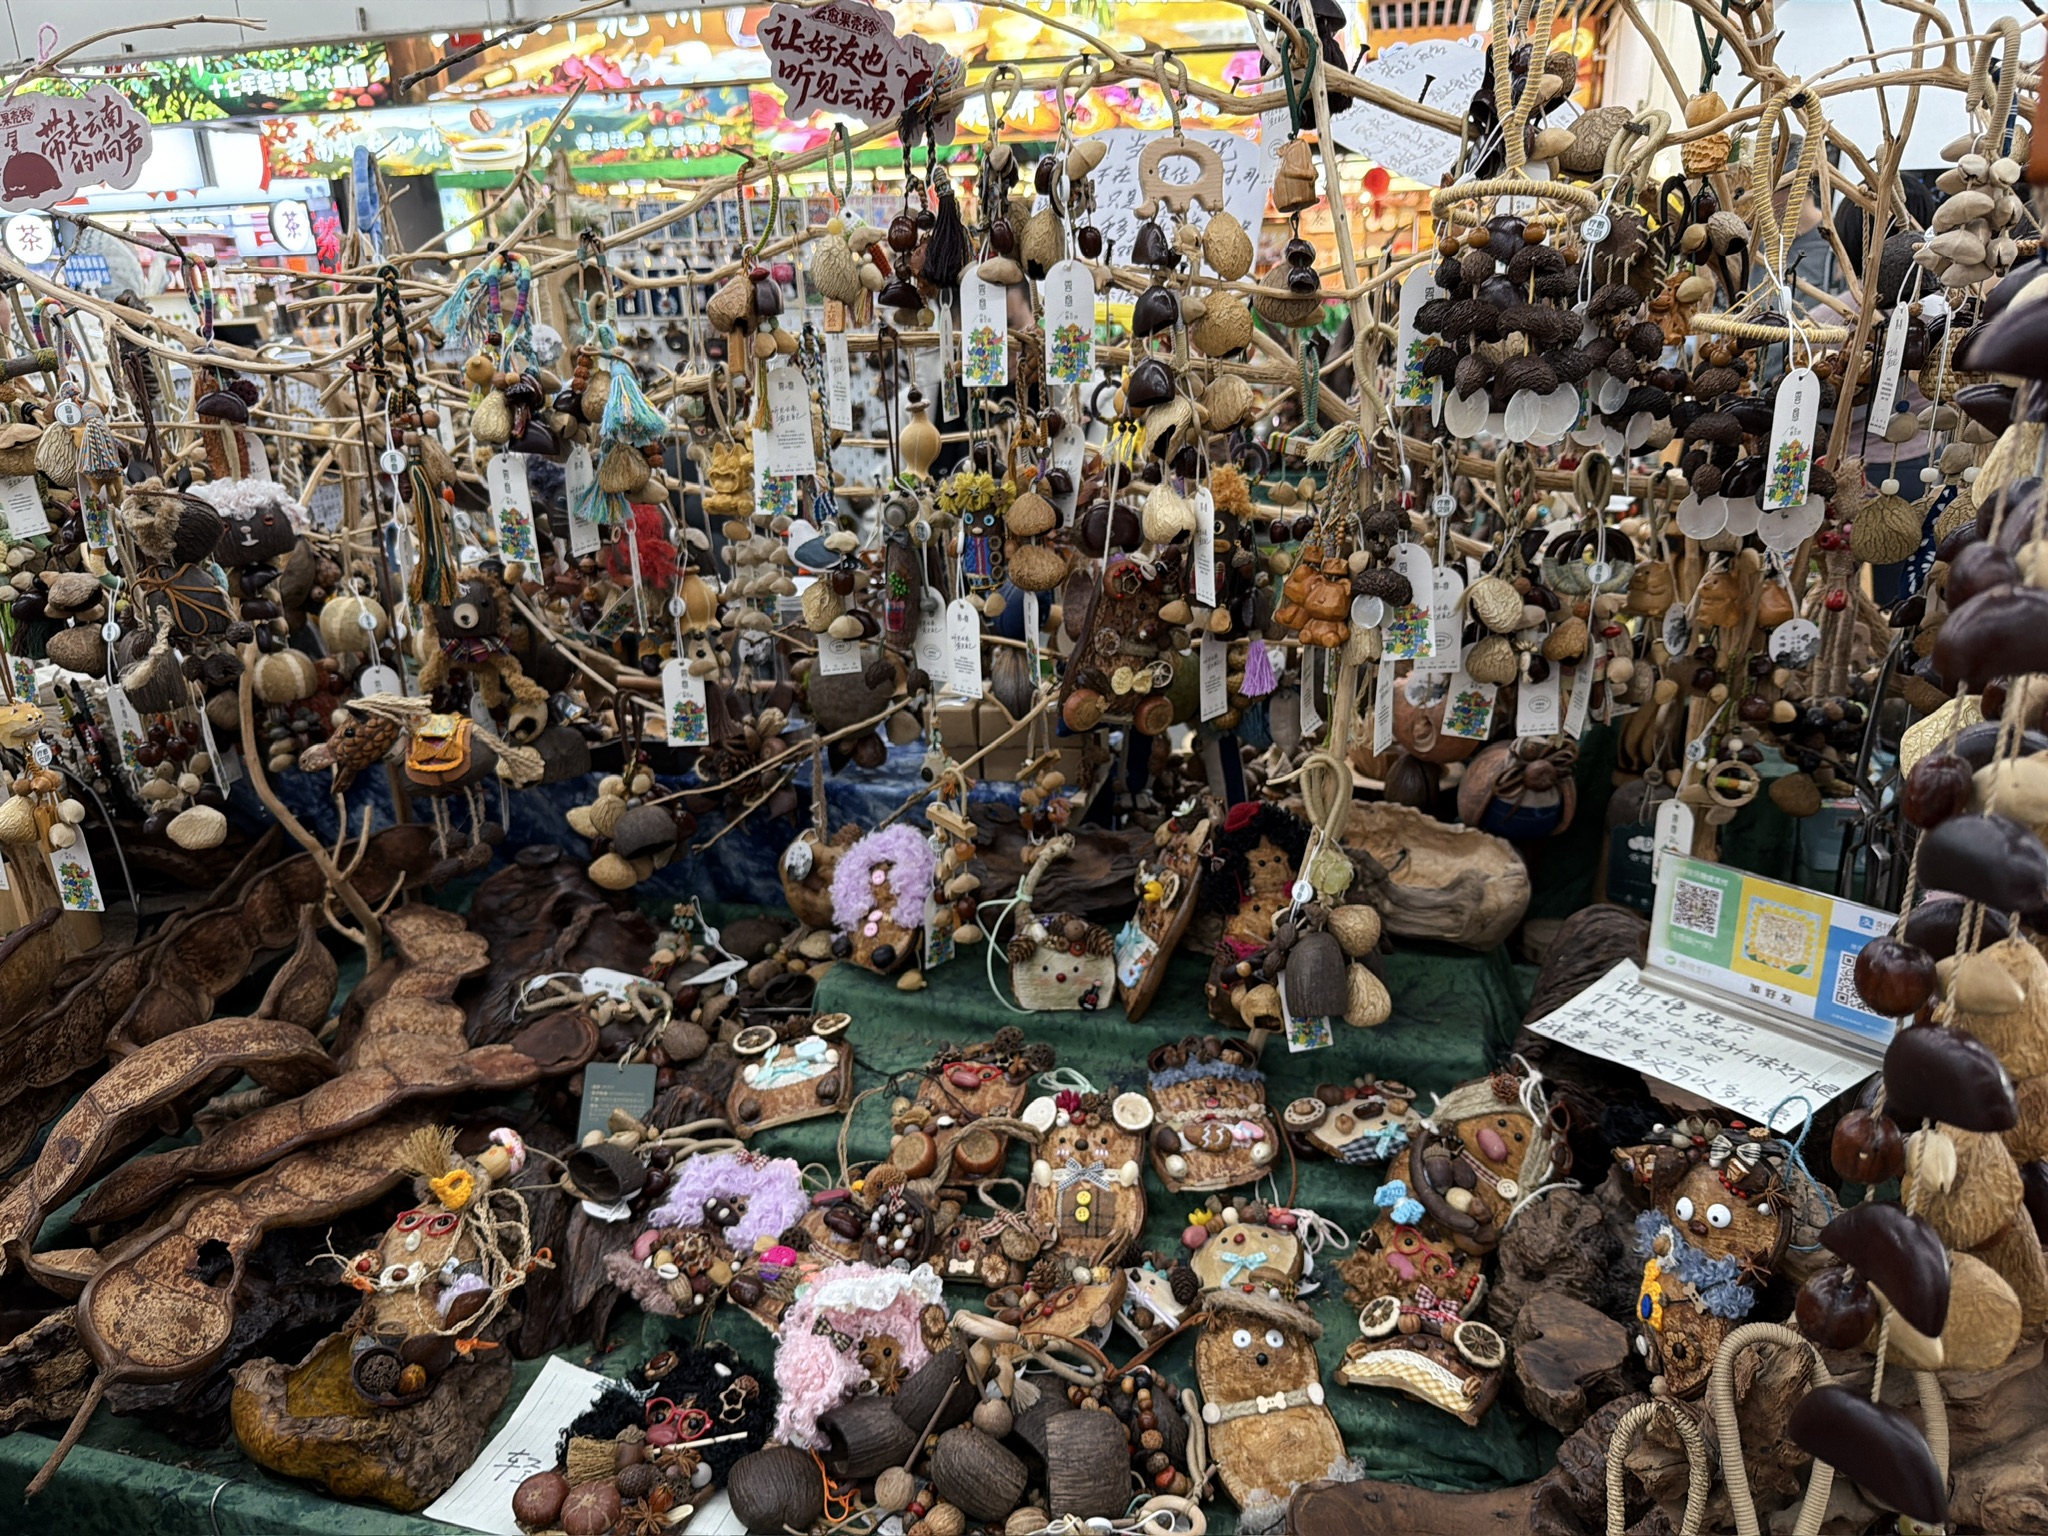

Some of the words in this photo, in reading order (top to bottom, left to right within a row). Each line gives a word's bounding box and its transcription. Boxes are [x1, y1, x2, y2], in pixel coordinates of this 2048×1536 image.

[764, 14, 888, 79] 让好友也
[0, 106, 34, 127] 果壳铃
[778, 58, 896, 119] 听见云南
[35, 95, 123, 172] 带走云南
[69, 119, 144, 178] 的响声
[16, 225, 43, 252] 茶
[1748, 982, 1793, 1007] 加好友
